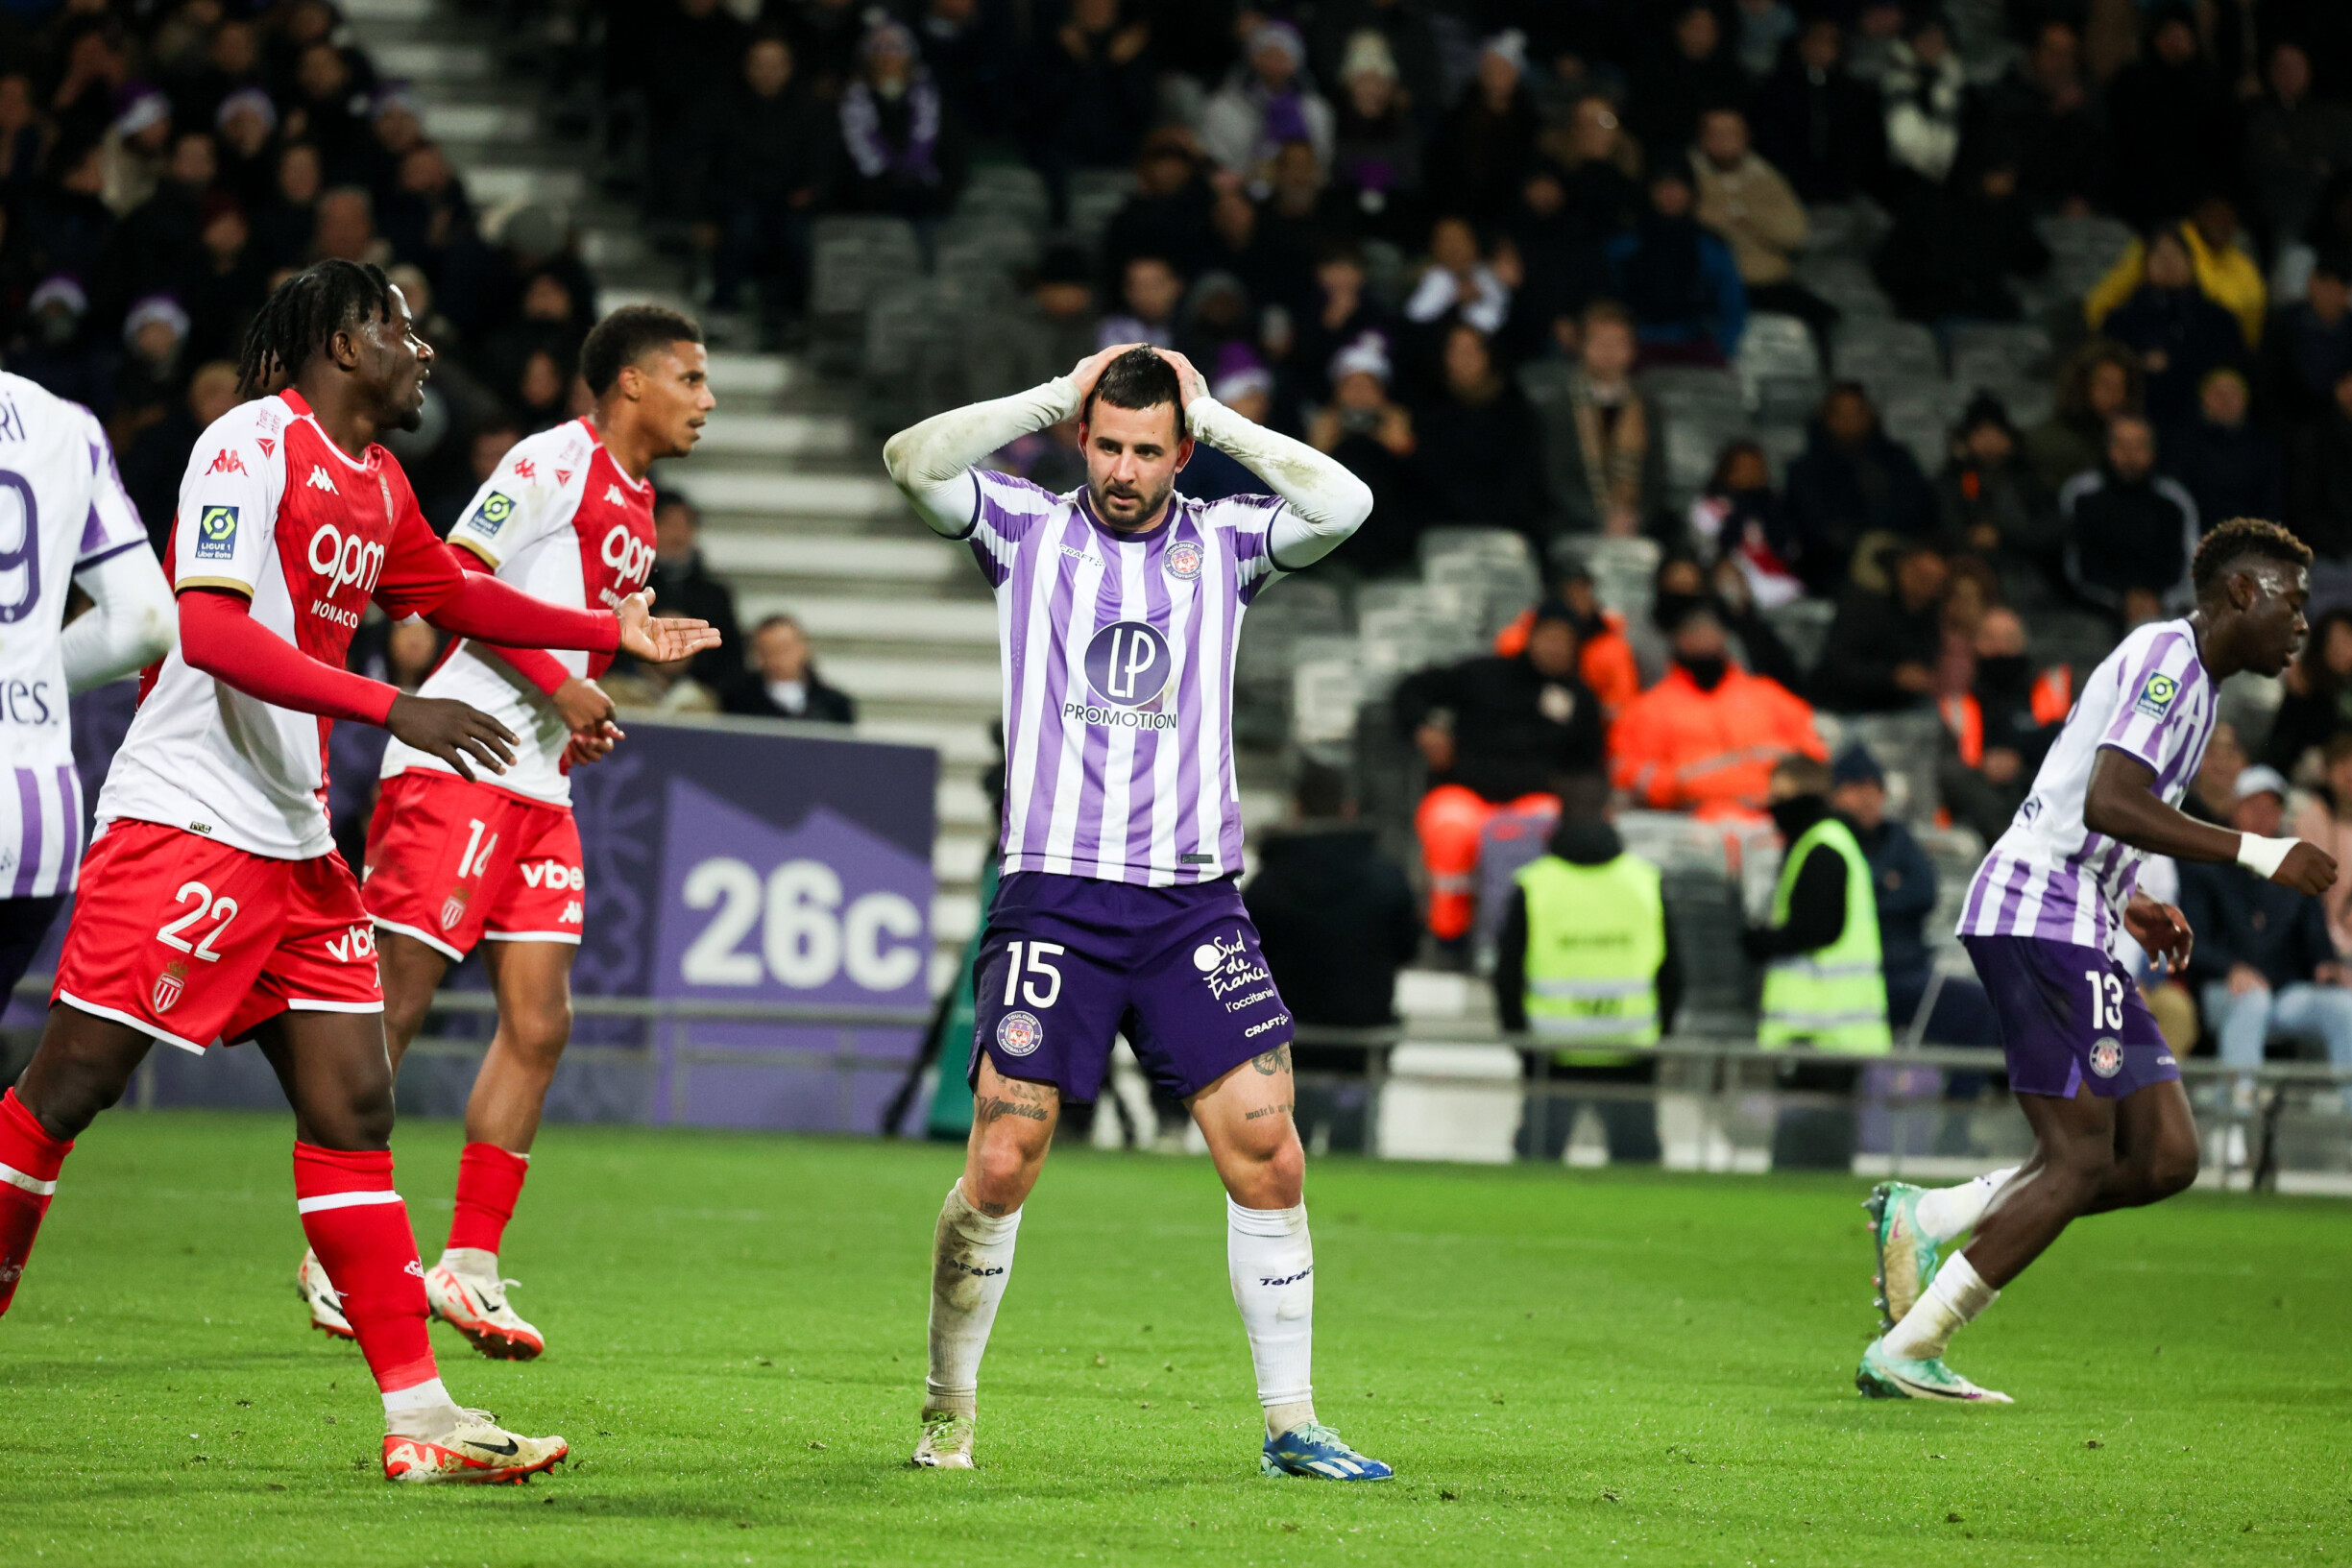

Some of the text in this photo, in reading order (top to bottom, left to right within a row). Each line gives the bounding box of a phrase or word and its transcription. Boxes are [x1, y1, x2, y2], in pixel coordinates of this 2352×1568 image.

[201, 542, 226, 550] LIGUE
[307, 523, 384, 598] apm
[310, 598, 358, 630] MONACO
[1107, 627, 1156, 698] LP
[1063, 703, 1177, 730] PROMOTION
[156, 880, 239, 963] 22
[680, 856, 923, 992] 26c
[1214, 929, 1247, 962] Sud
[1004, 940, 1065, 1009] 15
[1226, 955, 1251, 975] de
[1202, 965, 1269, 1001] France
[1225, 987, 1275, 1013] l'occitanie
[2085, 970, 2124, 1031] 13
[1245, 1016, 1281, 1038] CRAFT
